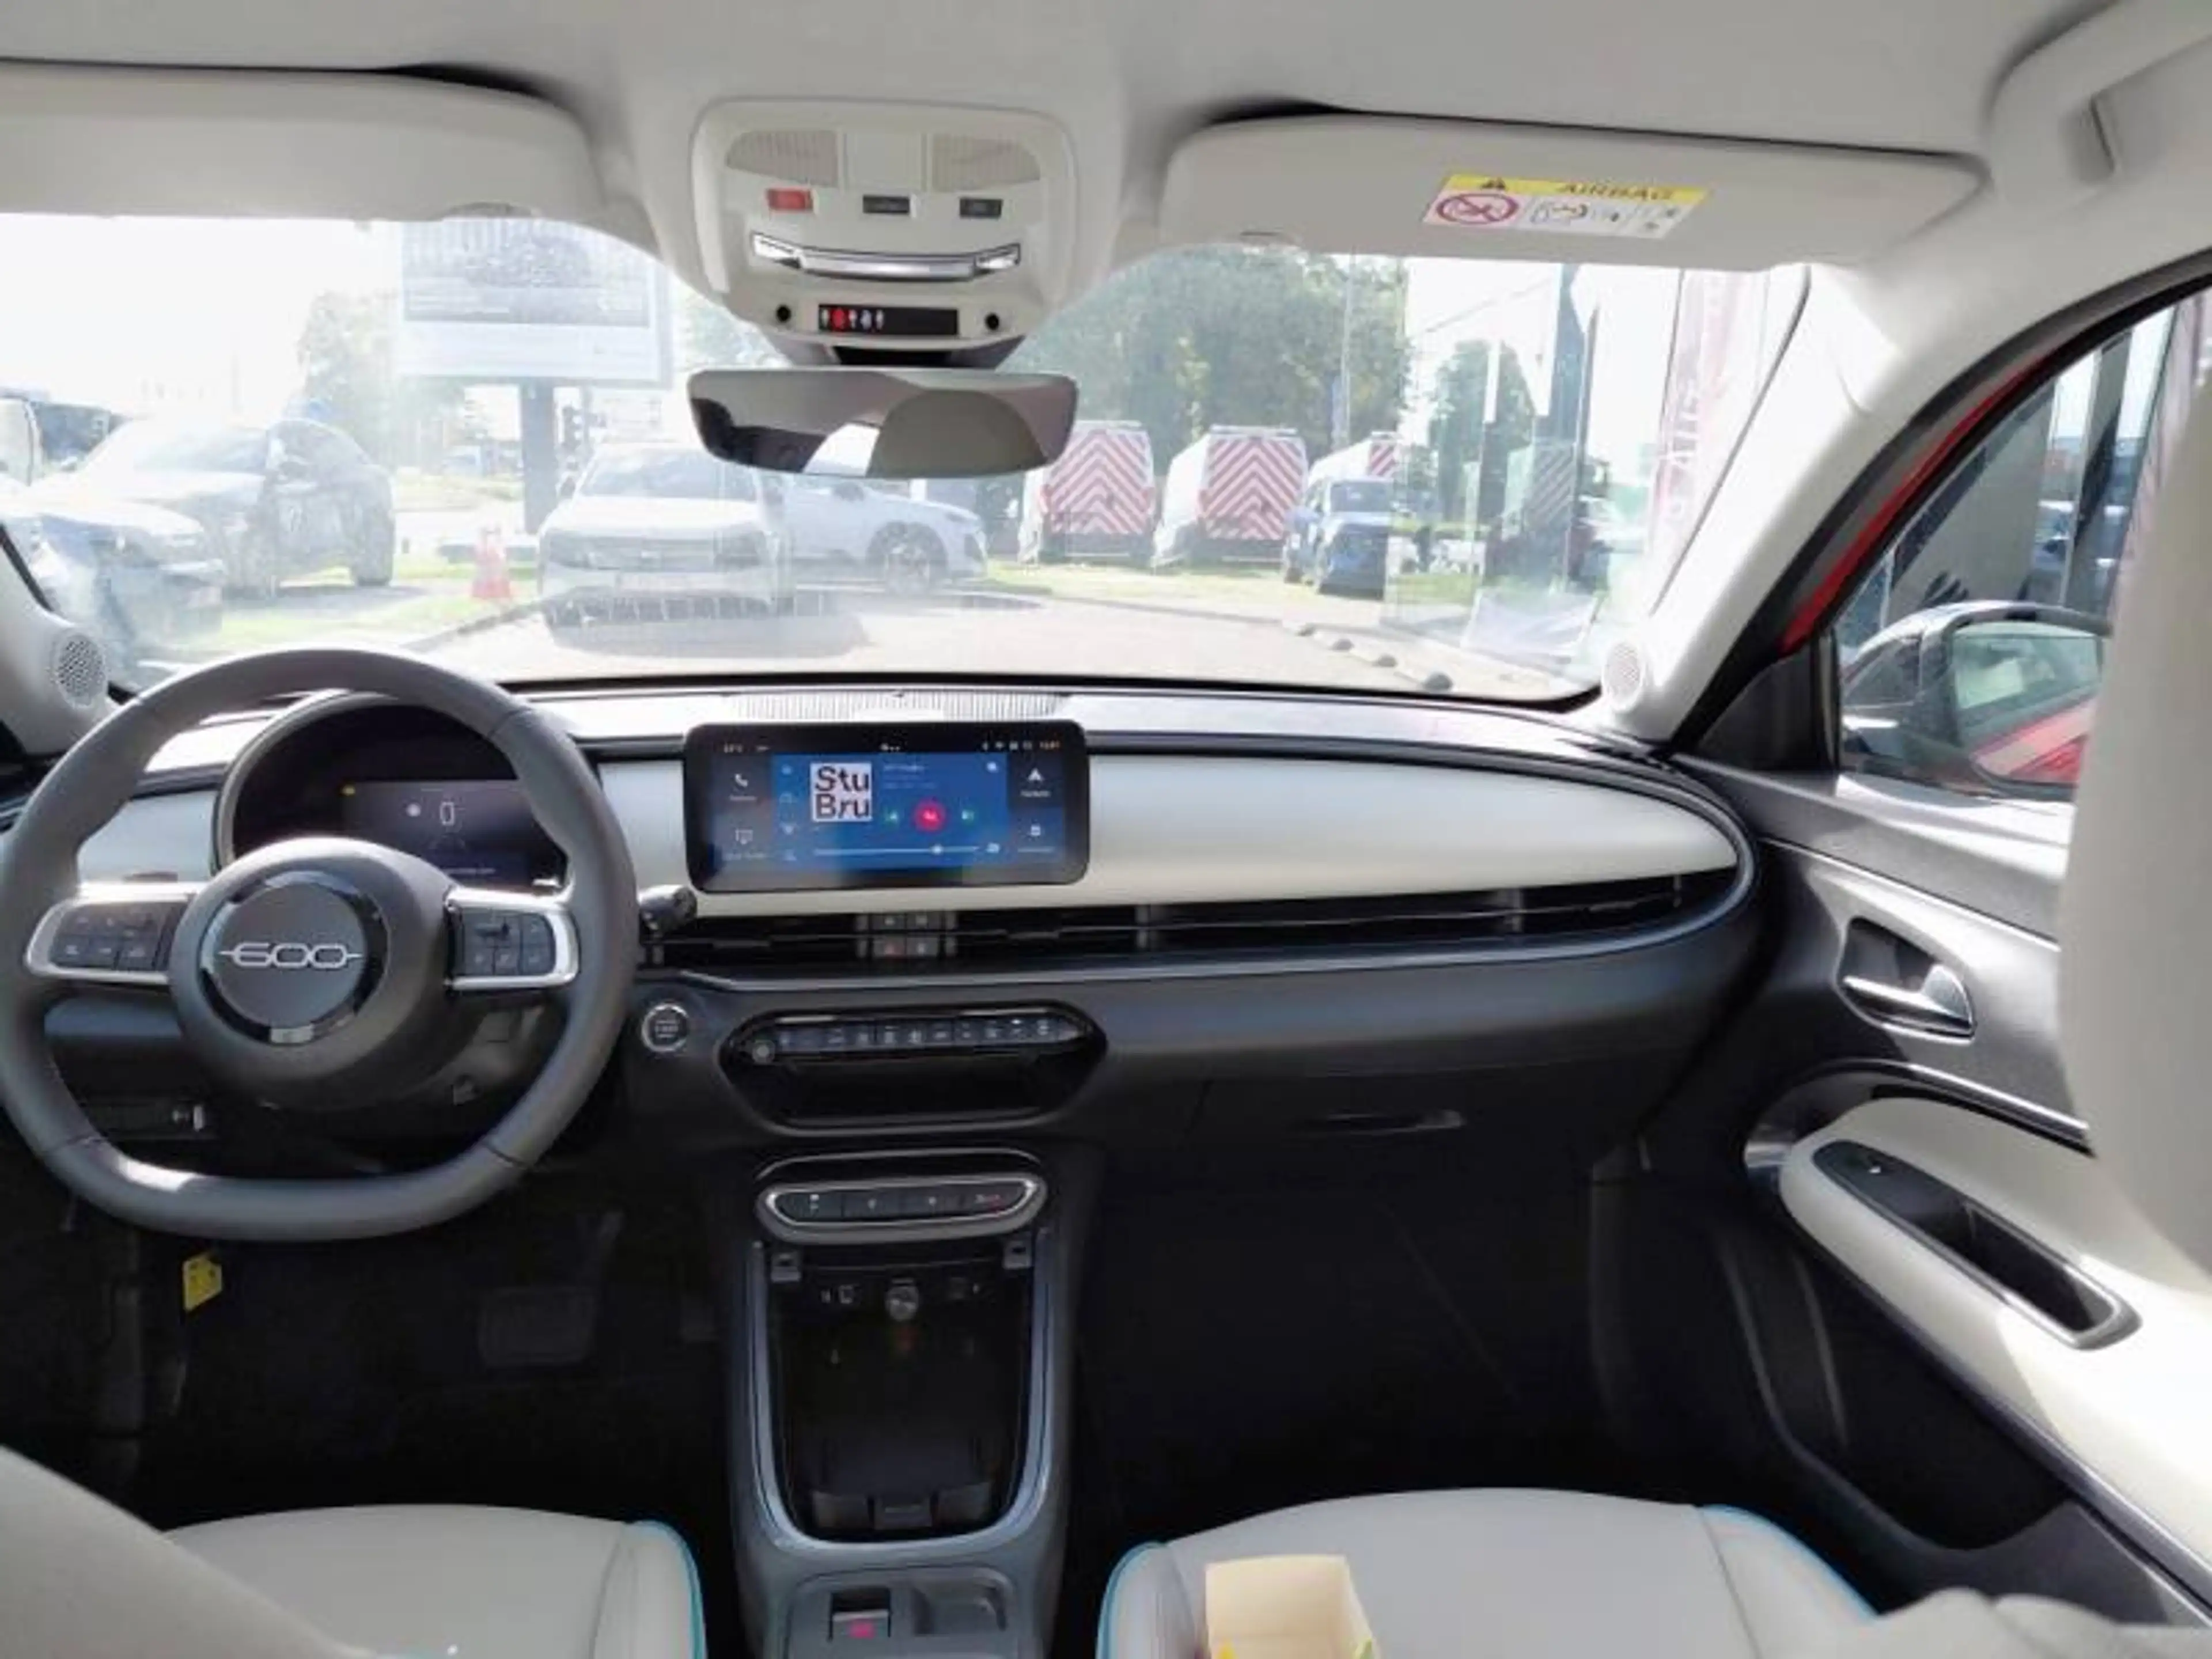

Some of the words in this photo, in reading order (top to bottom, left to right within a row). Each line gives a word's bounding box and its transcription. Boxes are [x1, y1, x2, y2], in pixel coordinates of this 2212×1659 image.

[815, 766, 869, 791] Stu
[816, 793, 870, 819] Bru
[232, 943, 349, 970] 600
